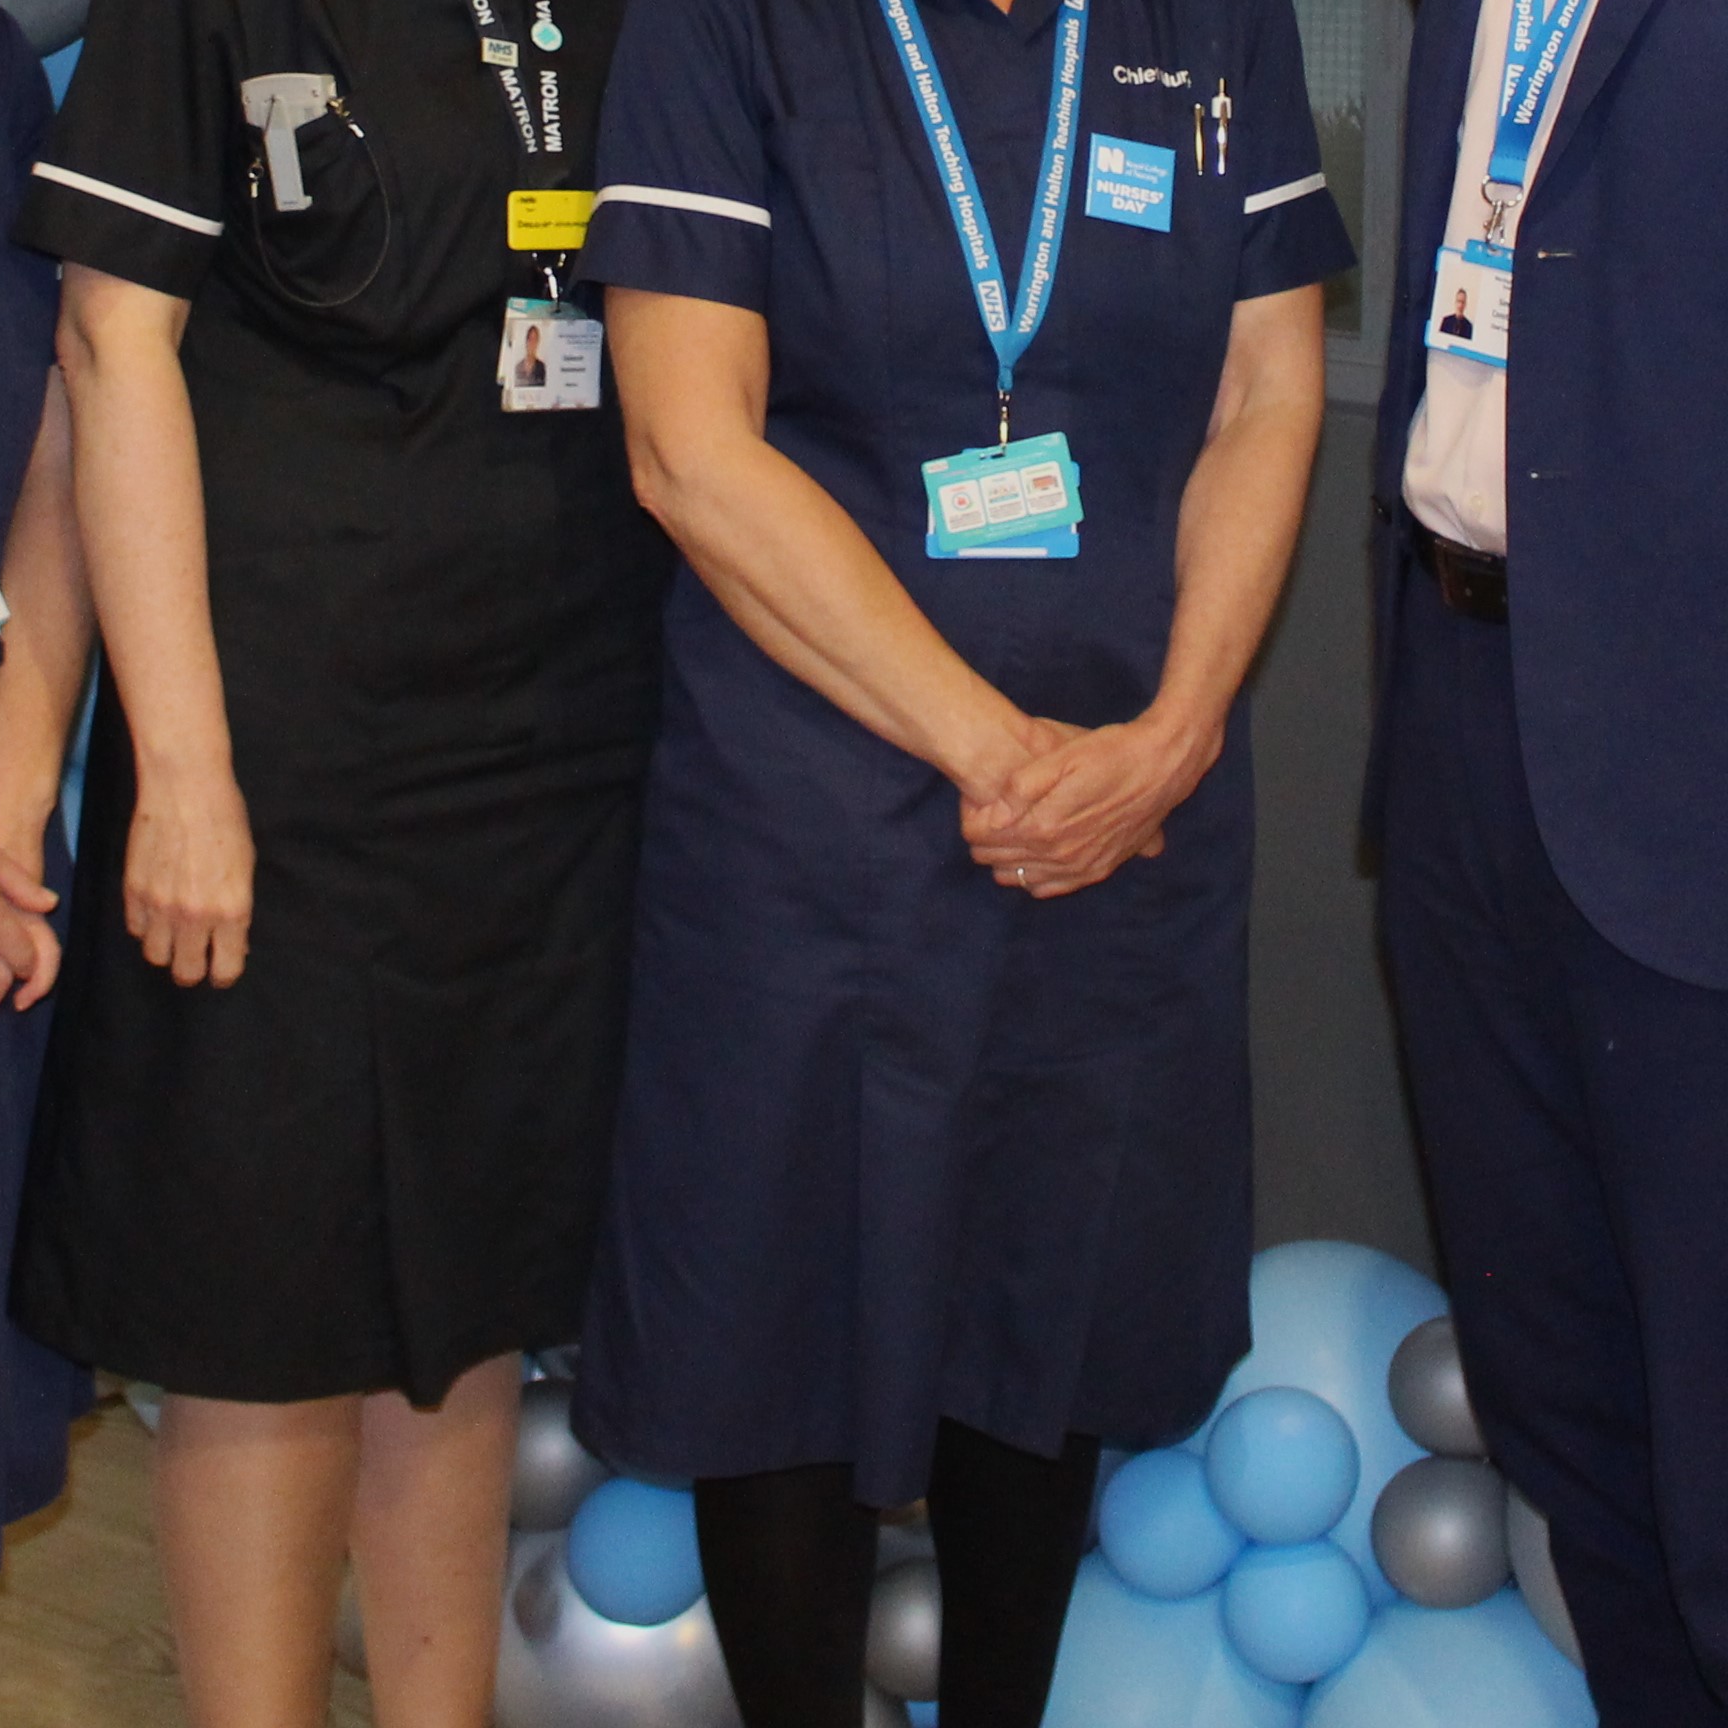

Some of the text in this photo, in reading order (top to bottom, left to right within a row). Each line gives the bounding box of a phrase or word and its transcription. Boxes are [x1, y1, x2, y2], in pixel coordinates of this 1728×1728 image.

[487, 41, 513, 55] NHS
[905, 40, 928, 71] and
[1060, 18, 1080, 85] Hospitals
[1513, 28, 1564, 125] Warrington
[499, 69, 538, 154] MATRON
[540, 70, 563, 153] MATRON
[916, 72, 942, 124] Halton
[1052, 88, 1077, 150] Teaching
[934, 125, 965, 193] Teaching
[1044, 154, 1065, 206] Halton
[957, 194, 988, 270] Hospitals
[1041, 207, 1057, 239] and
[1112, 196, 1147, 214] DAY
[980, 281, 1005, 331] NHS
[1018, 242, 1051, 334] Warrington
